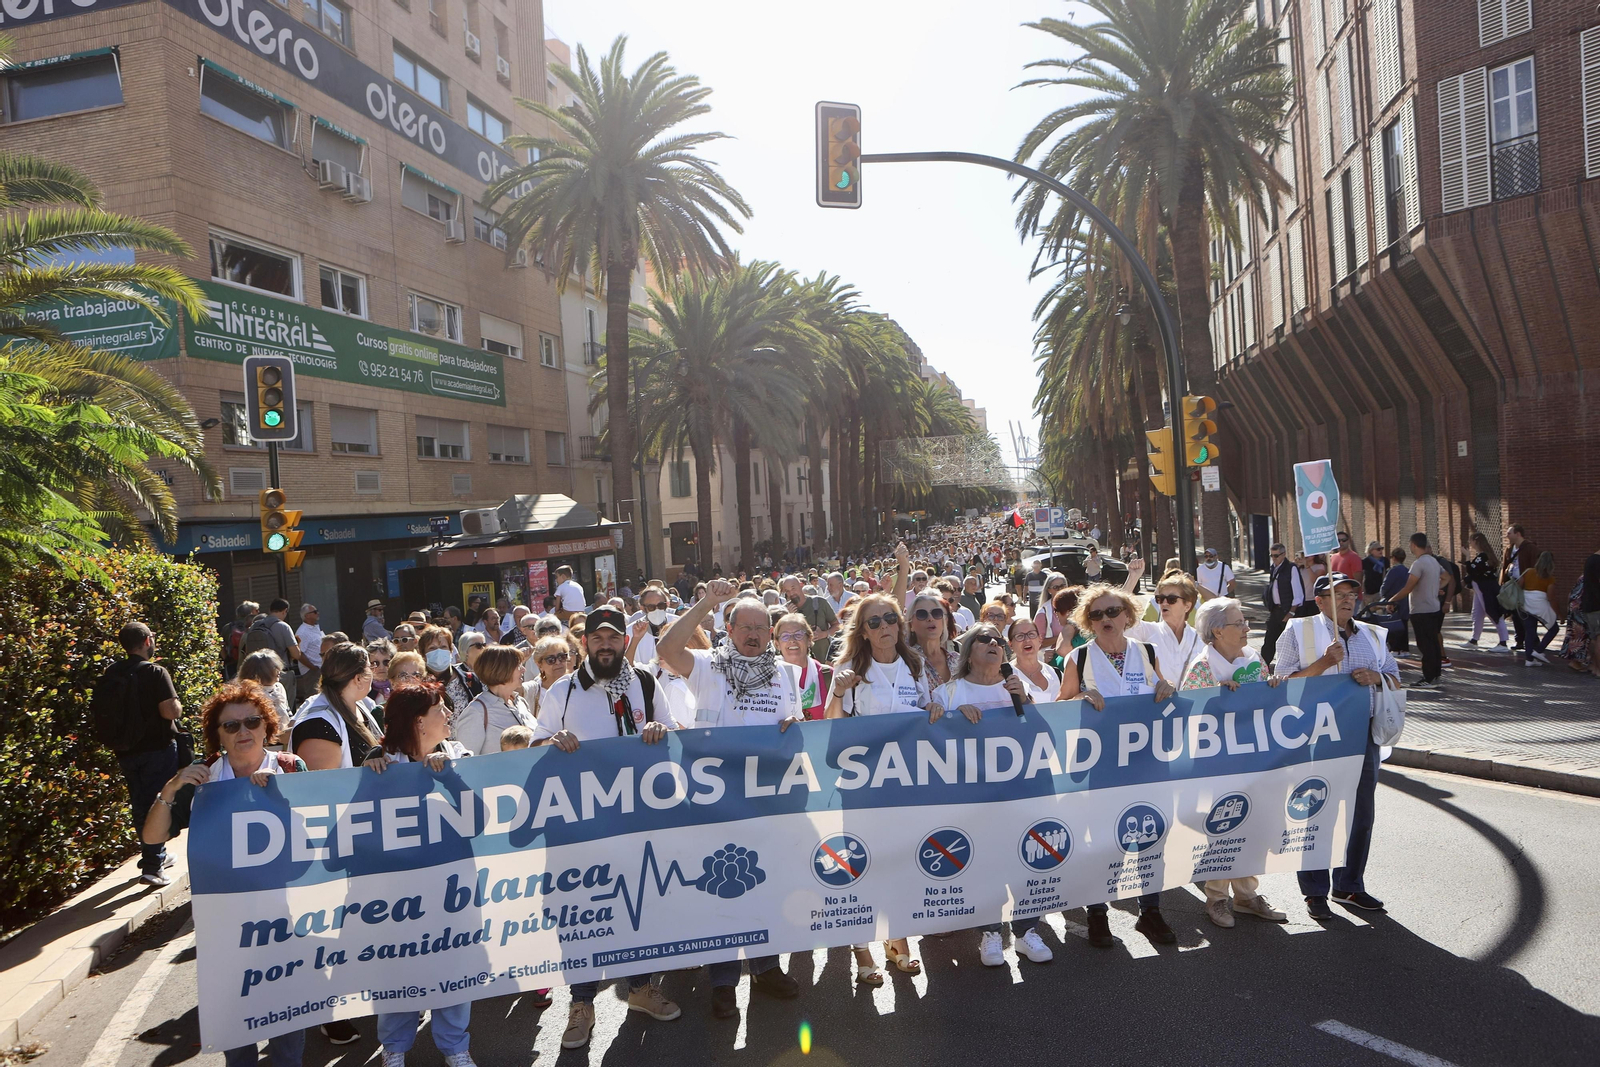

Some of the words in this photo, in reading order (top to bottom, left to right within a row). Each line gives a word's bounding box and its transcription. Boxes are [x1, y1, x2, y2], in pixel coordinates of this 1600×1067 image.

[199, 0, 319, 80] otero
[366, 82, 446, 154] otero
[63, 295, 160, 318] trabajadors
[231, 301, 300, 324] ACADEMIA
[224, 304, 312, 348] INTEGRAL
[194, 336, 232, 351] CENTRO
[236, 343, 247, 354] DE
[356, 332, 388, 350] Cursos
[389, 342, 412, 355] gratis
[414, 348, 438, 362] online
[439, 354, 456, 365] para
[456, 356, 497, 374] trabajadores
[370, 362, 387, 377] 952
[389, 367, 400, 378] 21
[401, 368, 412, 382] 54
[413, 370, 424, 383] 76
[1050, 508, 1062, 524] P
[208, 534, 251, 548] Sabadell
[324, 528, 356, 540] Sabadell
[472, 584, 490, 592] ATM
[231, 757, 726, 869] DEFENDAMOS
[744, 751, 822, 799] LA
[834, 728, 1102, 790] SANIDAD
[1117, 702, 1342, 767] PÚBLICA
[1282, 824, 1319, 838] Asistencia
[1192, 844, 1207, 852] Más
[1215, 837, 1246, 846] Mejores
[1282, 834, 1315, 846] Sanitaria
[1192, 846, 1242, 860] Instalaciones
[1279, 843, 1315, 854] Universal
[1108, 862, 1124, 870] Más
[1127, 852, 1161, 866] Personal
[1121, 863, 1152, 874] Mejores
[1200, 856, 1235, 866] Servicios
[1192, 864, 1232, 875] Sanitarios
[1049, 876, 1061, 884] las
[1107, 871, 1154, 886] Condiciones
[926, 887, 939, 896] No
[949, 885, 963, 894] los
[1030, 886, 1055, 896] Listas
[1108, 886, 1117, 894] de
[1121, 880, 1150, 892] Trabajo
[239, 894, 426, 948] marea
[443, 863, 614, 913] blanca
[825, 896, 838, 905] No
[849, 894, 858, 903] la
[924, 896, 964, 907] Recortes
[1019, 898, 1030, 906] de
[1032, 894, 1060, 905] espera
[810, 904, 873, 919] Privatización
[927, 909, 935, 918] la
[938, 906, 975, 917] Sanidad
[1010, 900, 1068, 916] Interminables
[810, 922, 822, 931] de
[824, 920, 833, 930] la
[836, 915, 873, 928] Sanidad
[559, 926, 614, 943] MÁLAGA
[240, 960, 304, 997] por
[314, 946, 348, 970] la
[358, 918, 492, 962] sanidad
[500, 905, 614, 947] pública
[597, 951, 635, 965] JUNT@S
[639, 948, 659, 958] POR
[678, 939, 722, 951] SANIDAD
[725, 933, 766, 945] PÚBLICA
[244, 995, 347, 1030] Trabajador@s
[361, 985, 427, 1002] Usuari@s
[439, 971, 496, 993] Vecin@s
[508, 957, 587, 979] Estudiantes
